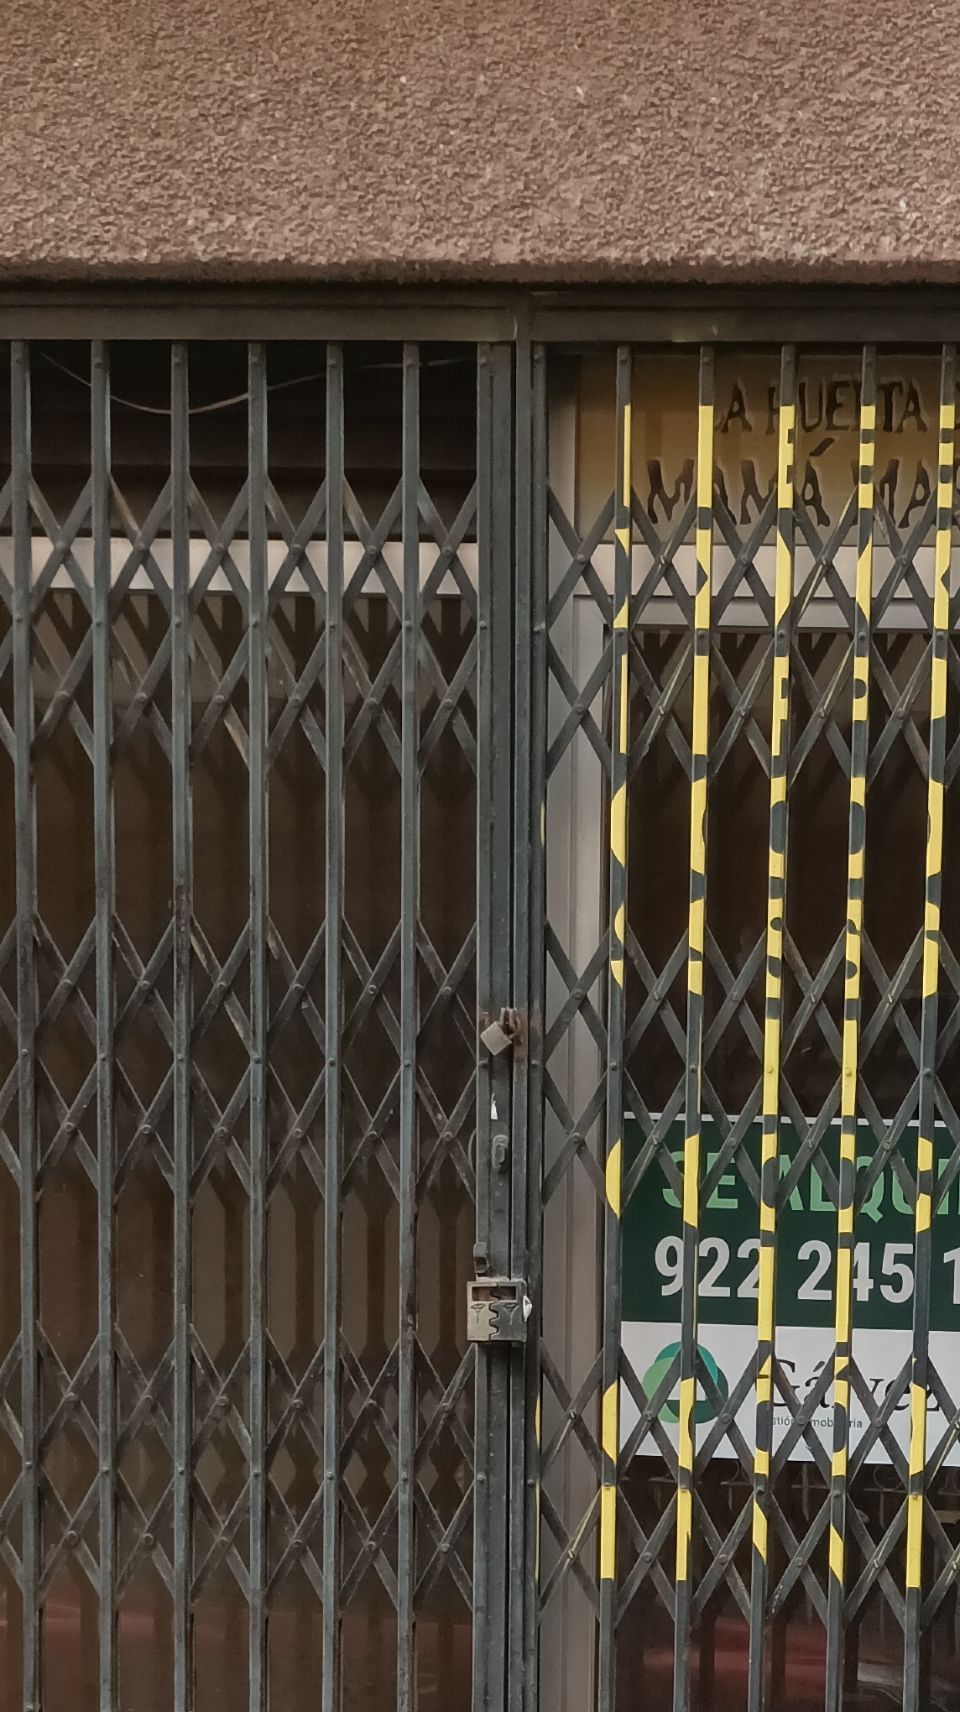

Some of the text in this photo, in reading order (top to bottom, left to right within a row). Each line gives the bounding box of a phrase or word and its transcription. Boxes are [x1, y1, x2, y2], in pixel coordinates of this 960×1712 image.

[766, 379, 927, 434] HUETA
[662, 1150, 739, 1209] SE
[654, 1235, 768, 1298] 922
[797, 1239, 915, 1304] 245
